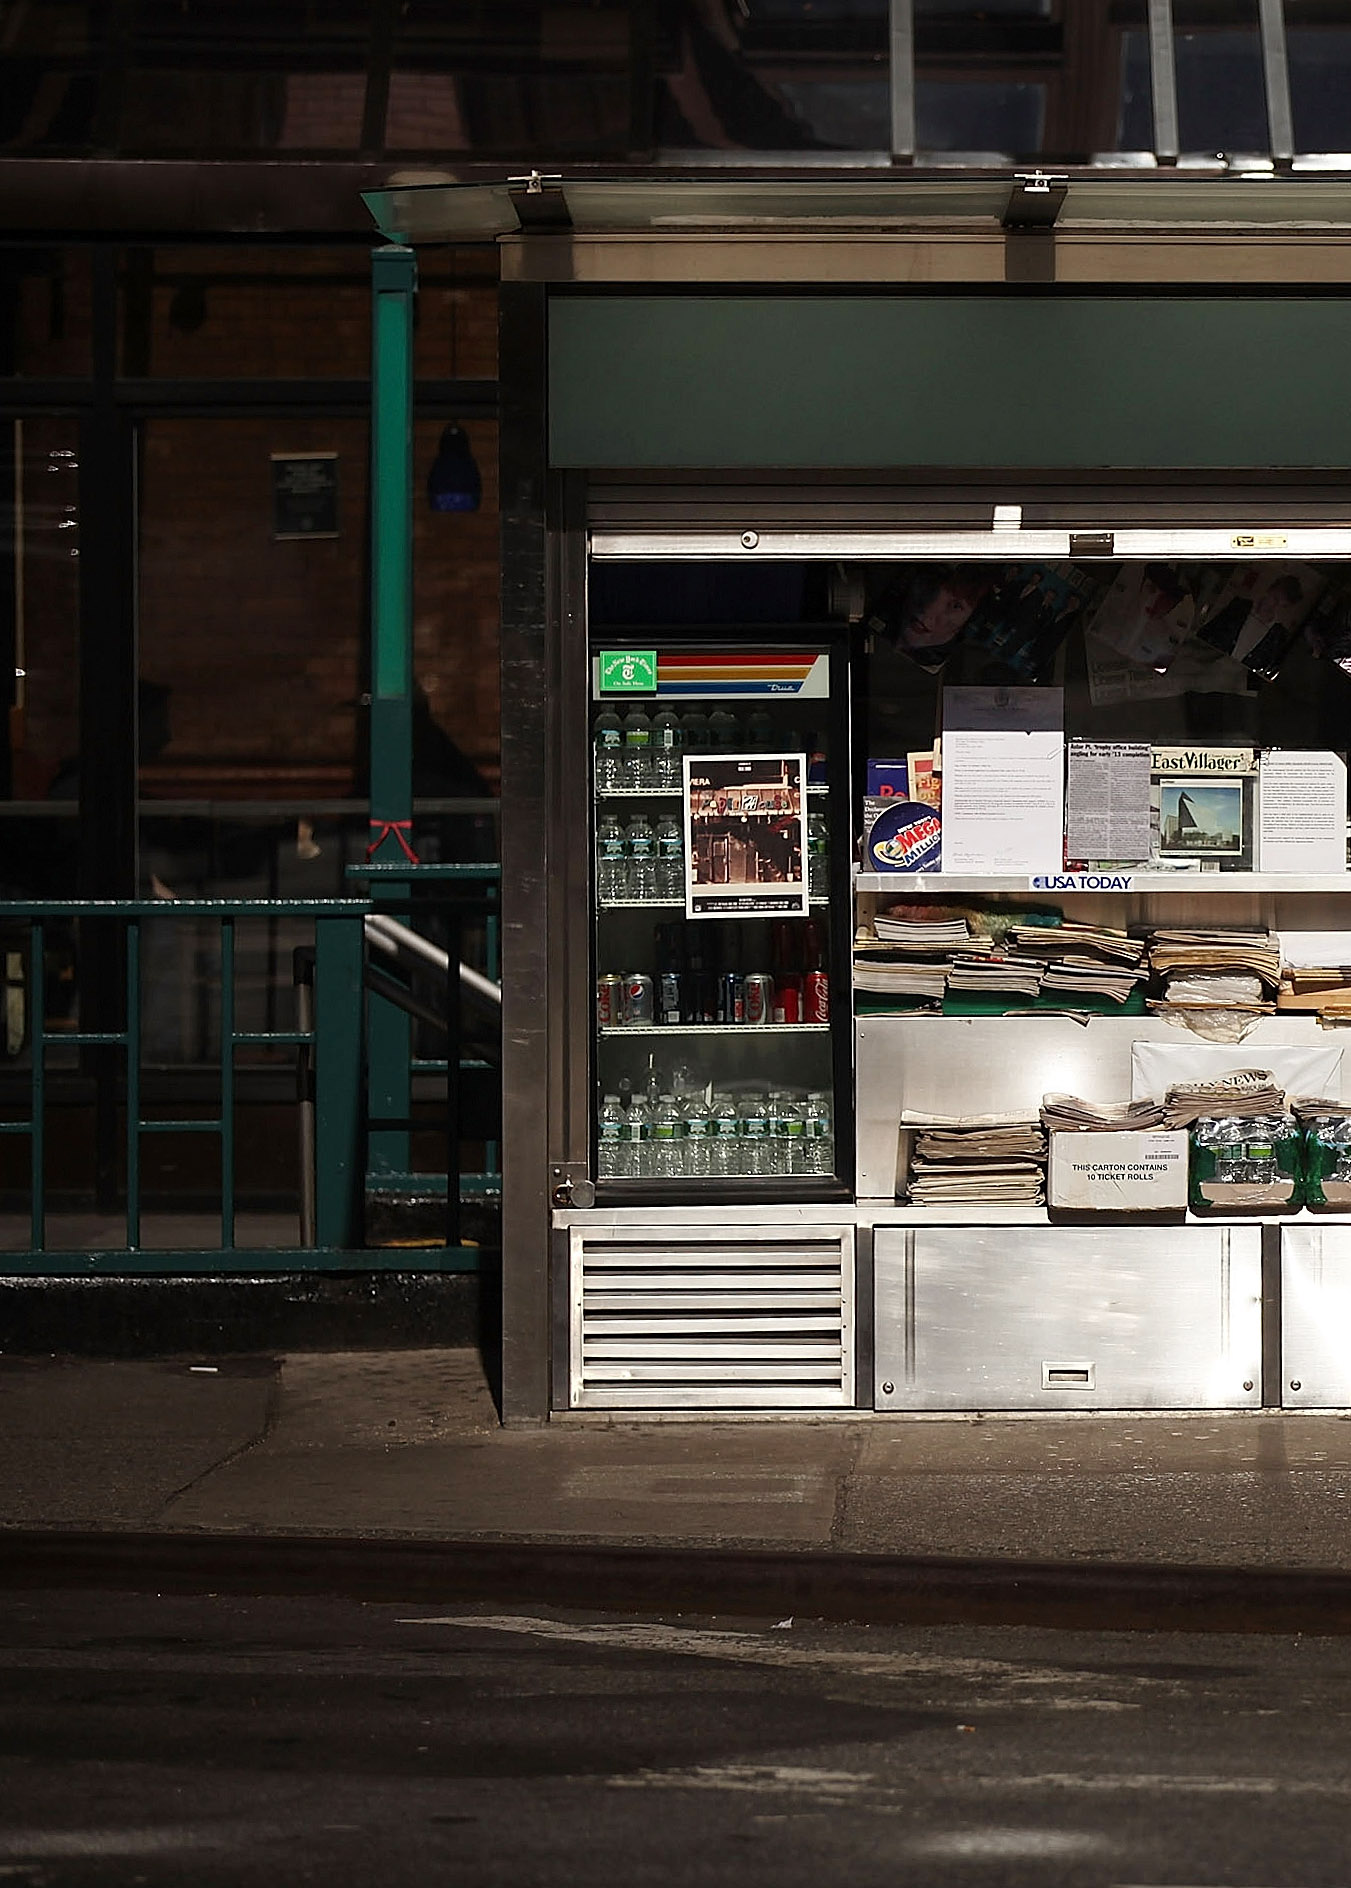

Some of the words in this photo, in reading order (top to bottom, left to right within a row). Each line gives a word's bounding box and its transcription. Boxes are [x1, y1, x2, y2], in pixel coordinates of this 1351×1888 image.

[895, 817, 941, 854] MEGA
[1045, 876, 1075, 889] USA
[1078, 876, 1131, 889] TODAY
[1222, 1070, 1269, 1087] NEWS
[1072, 1163, 1090, 1171] THIS
[1092, 1163, 1126, 1171] CARTON
[1127, 1163, 1168, 1171] CONTAINS
[1087, 1173, 1096, 1181] 10
[1097, 1173, 1126, 1181] TICKET
[1127, 1173, 1154, 1181] ROLLS
